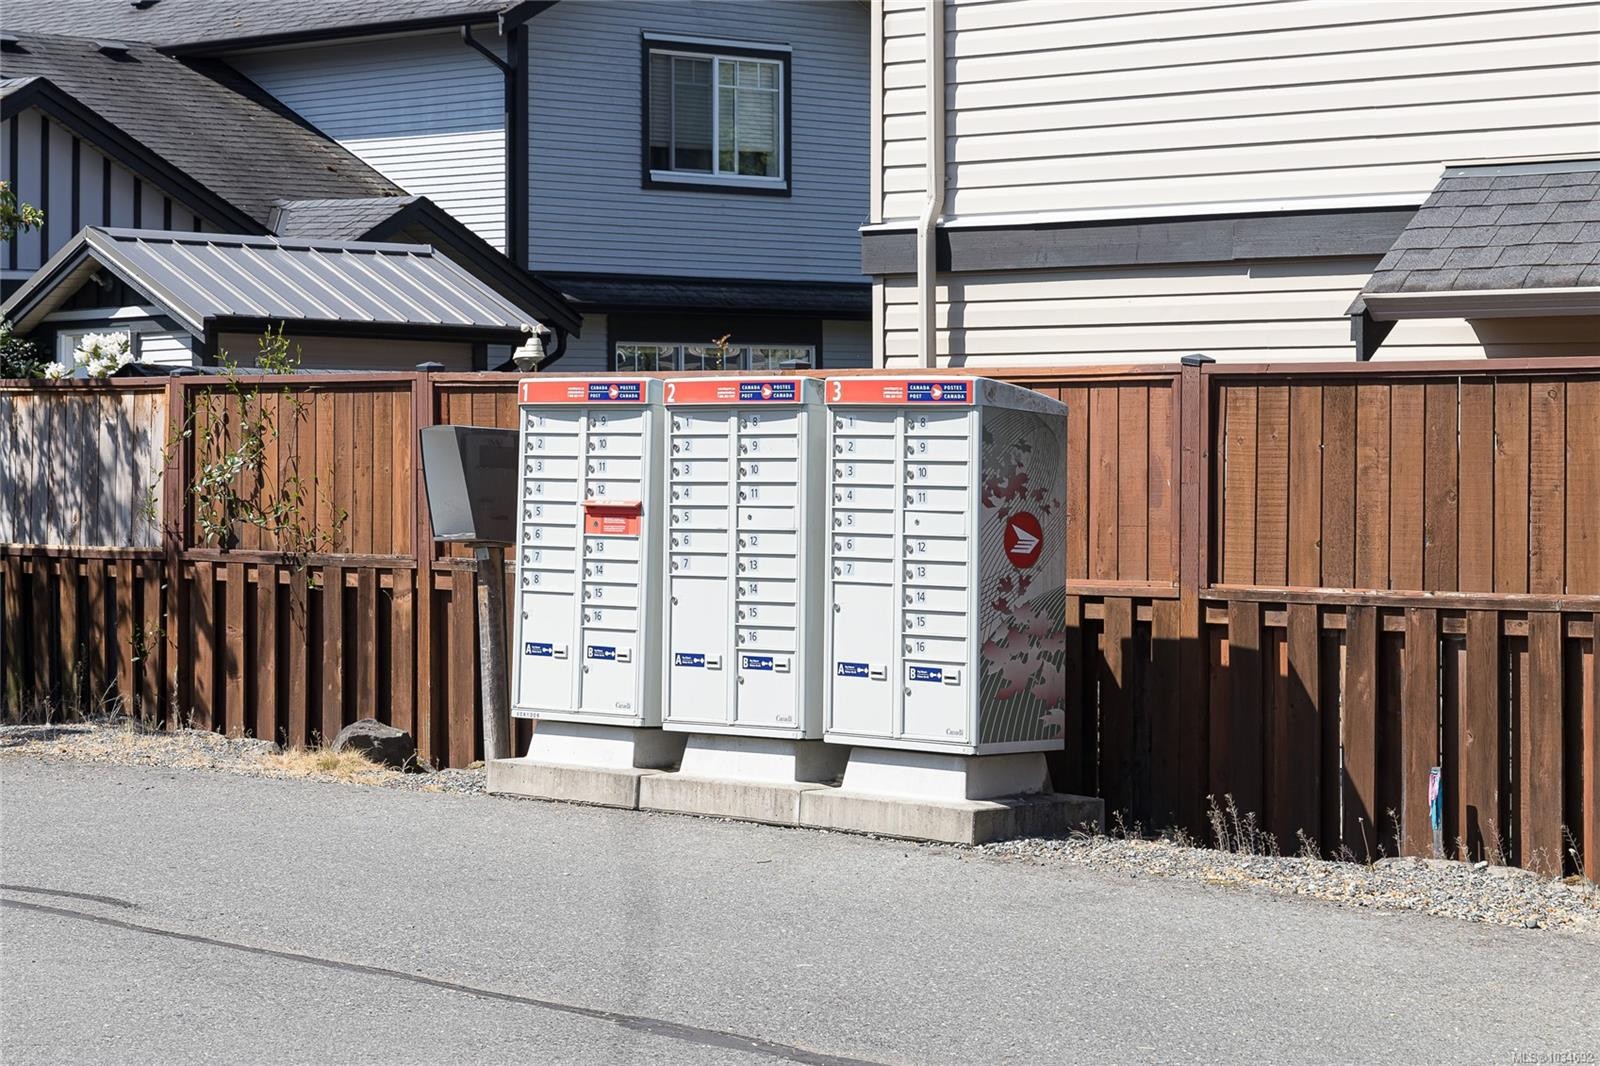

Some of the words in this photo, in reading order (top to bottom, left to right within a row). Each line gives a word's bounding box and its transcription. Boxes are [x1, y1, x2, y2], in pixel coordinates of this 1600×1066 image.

[523, 384, 528, 401] 1
[668, 384, 675, 402] 2
[832, 382, 841, 401] 3
[601, 416, 606, 425] 9
[686, 418, 689, 426] 1
[752, 417, 757, 426] 8
[850, 418, 852, 426] 1
[920, 418, 925, 427] 8
[538, 440, 542, 448] 2
[600, 440, 606, 448] 10
[685, 442, 690, 450] 2
[752, 441, 757, 450] 9
[848, 442, 853, 451] 2
[920, 443, 925, 452] 9
[599, 462, 605, 471] 11
[685, 465, 689, 474] 3
[752, 465, 758, 474] 10
[848, 467, 852, 475] 3
[919, 468, 926, 477] 10
[598, 485, 604, 494] 12
[684, 489, 689, 497] 4
[751, 489, 758, 497] 11
[847, 491, 852, 500] 4
[919, 493, 926, 502] 11
[684, 512, 688, 520] 5
[848, 515, 852, 524] 5
[535, 530, 540, 538] 6
[684, 536, 688, 544] 6
[750, 536, 757, 545] 12
[847, 540, 852, 549] 6
[597, 542, 604, 551] 13
[918, 542, 925, 552] 12
[535, 552, 539, 560] 7
[684, 559, 688, 568] 7
[750, 560, 757, 569] 13
[596, 566, 603, 574] 14
[847, 564, 851, 573] 7
[918, 567, 925, 576] 13
[534, 575, 539, 583] 8
[595, 588, 602, 597] 15
[750, 584, 757, 593] 14
[918, 592, 925, 601] 14
[594, 611, 602, 620] 16
[750, 608, 757, 617] 15
[917, 617, 925, 626] 15
[749, 632, 757, 641] 16
[526, 644, 532, 654] A
[917, 642, 924, 651] 16
[588, 647, 593, 657] B
[675, 654, 682, 665] A
[743, 658, 748, 668] B
[838, 664, 845, 674] A
[910, 668, 916, 679] B
